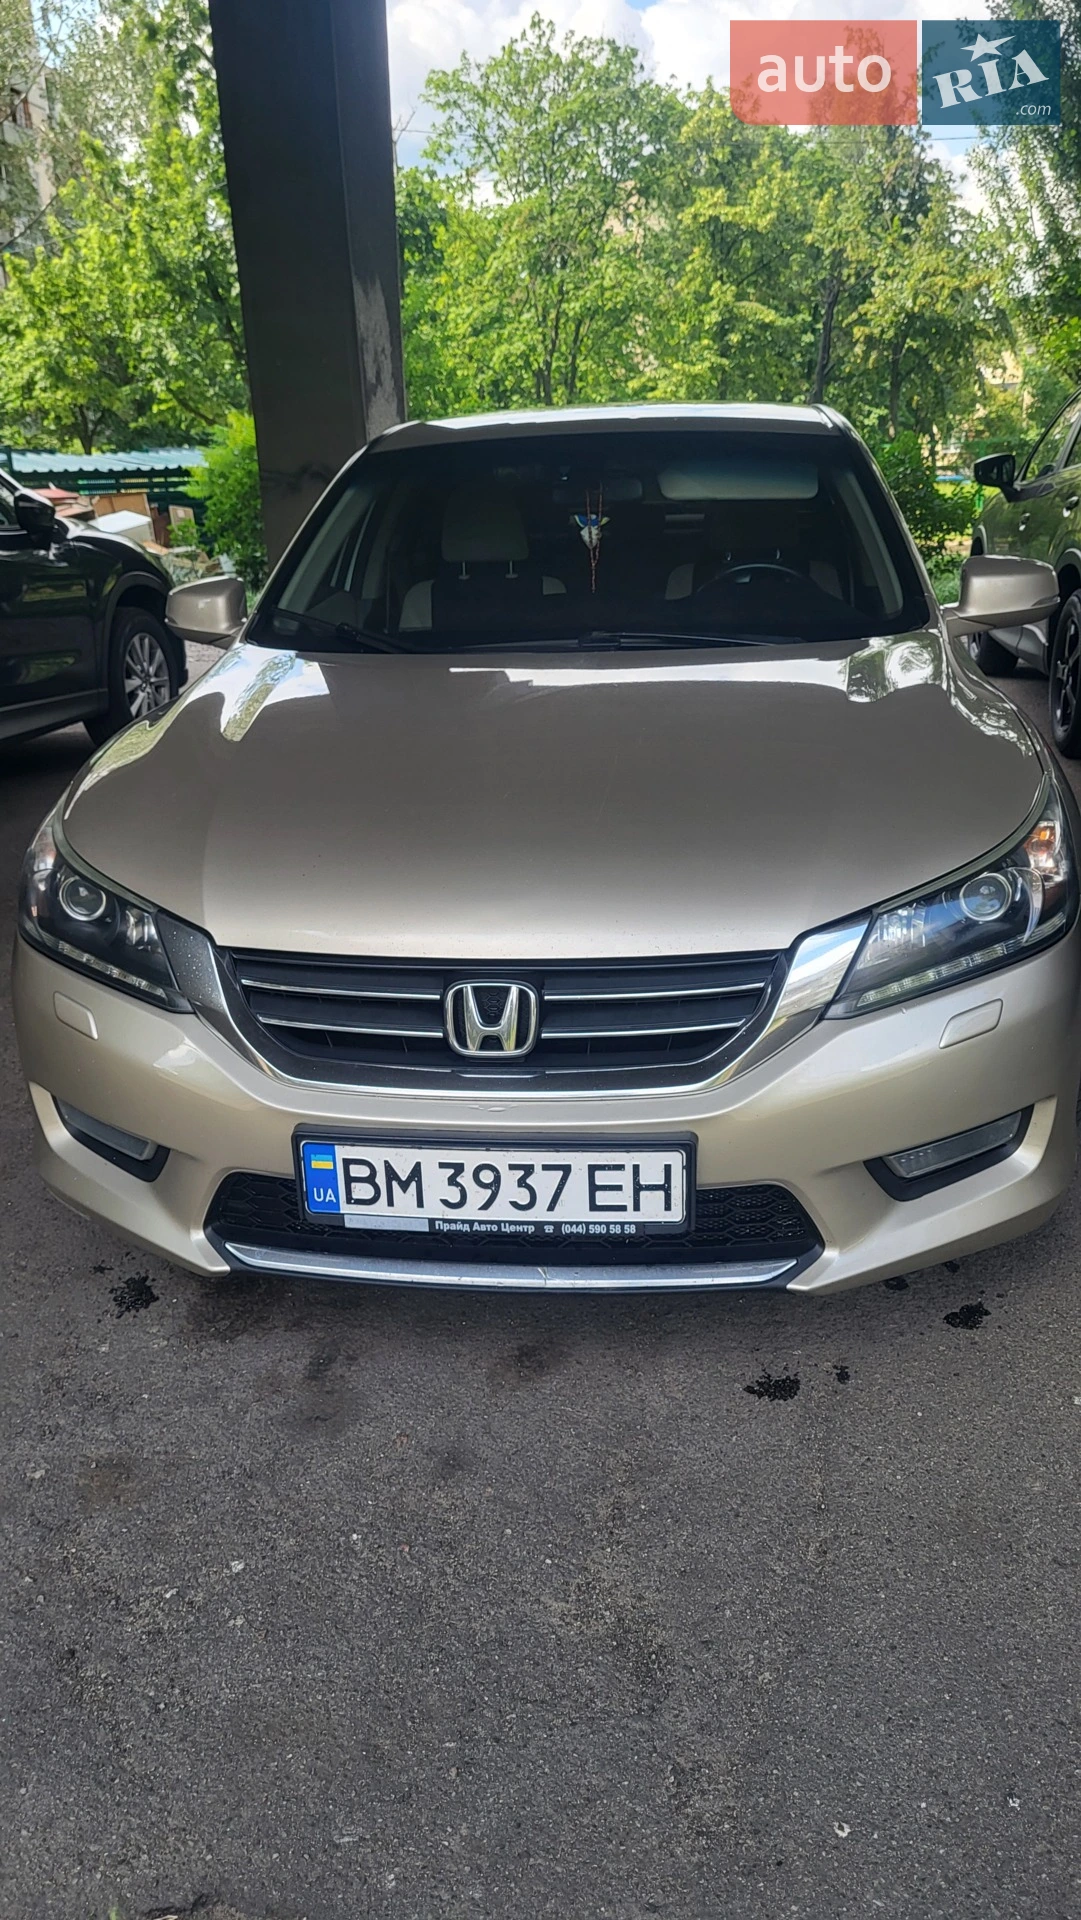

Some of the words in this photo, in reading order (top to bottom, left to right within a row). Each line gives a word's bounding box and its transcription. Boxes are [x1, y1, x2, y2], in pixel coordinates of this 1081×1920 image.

[313, 1187, 336, 1203] UA
[438, 1162, 572, 1212] 3937
[435, 1220, 470, 1233] Прайд
[473, 1222, 498, 1233] Авто
[501, 1222, 535, 1235] Центр
[561, 1223, 587, 1235] (044)
[588, 1224, 608, 1235] 590
[610, 1224, 622, 1235] 58
[624, 1224, 636, 1235] 58
